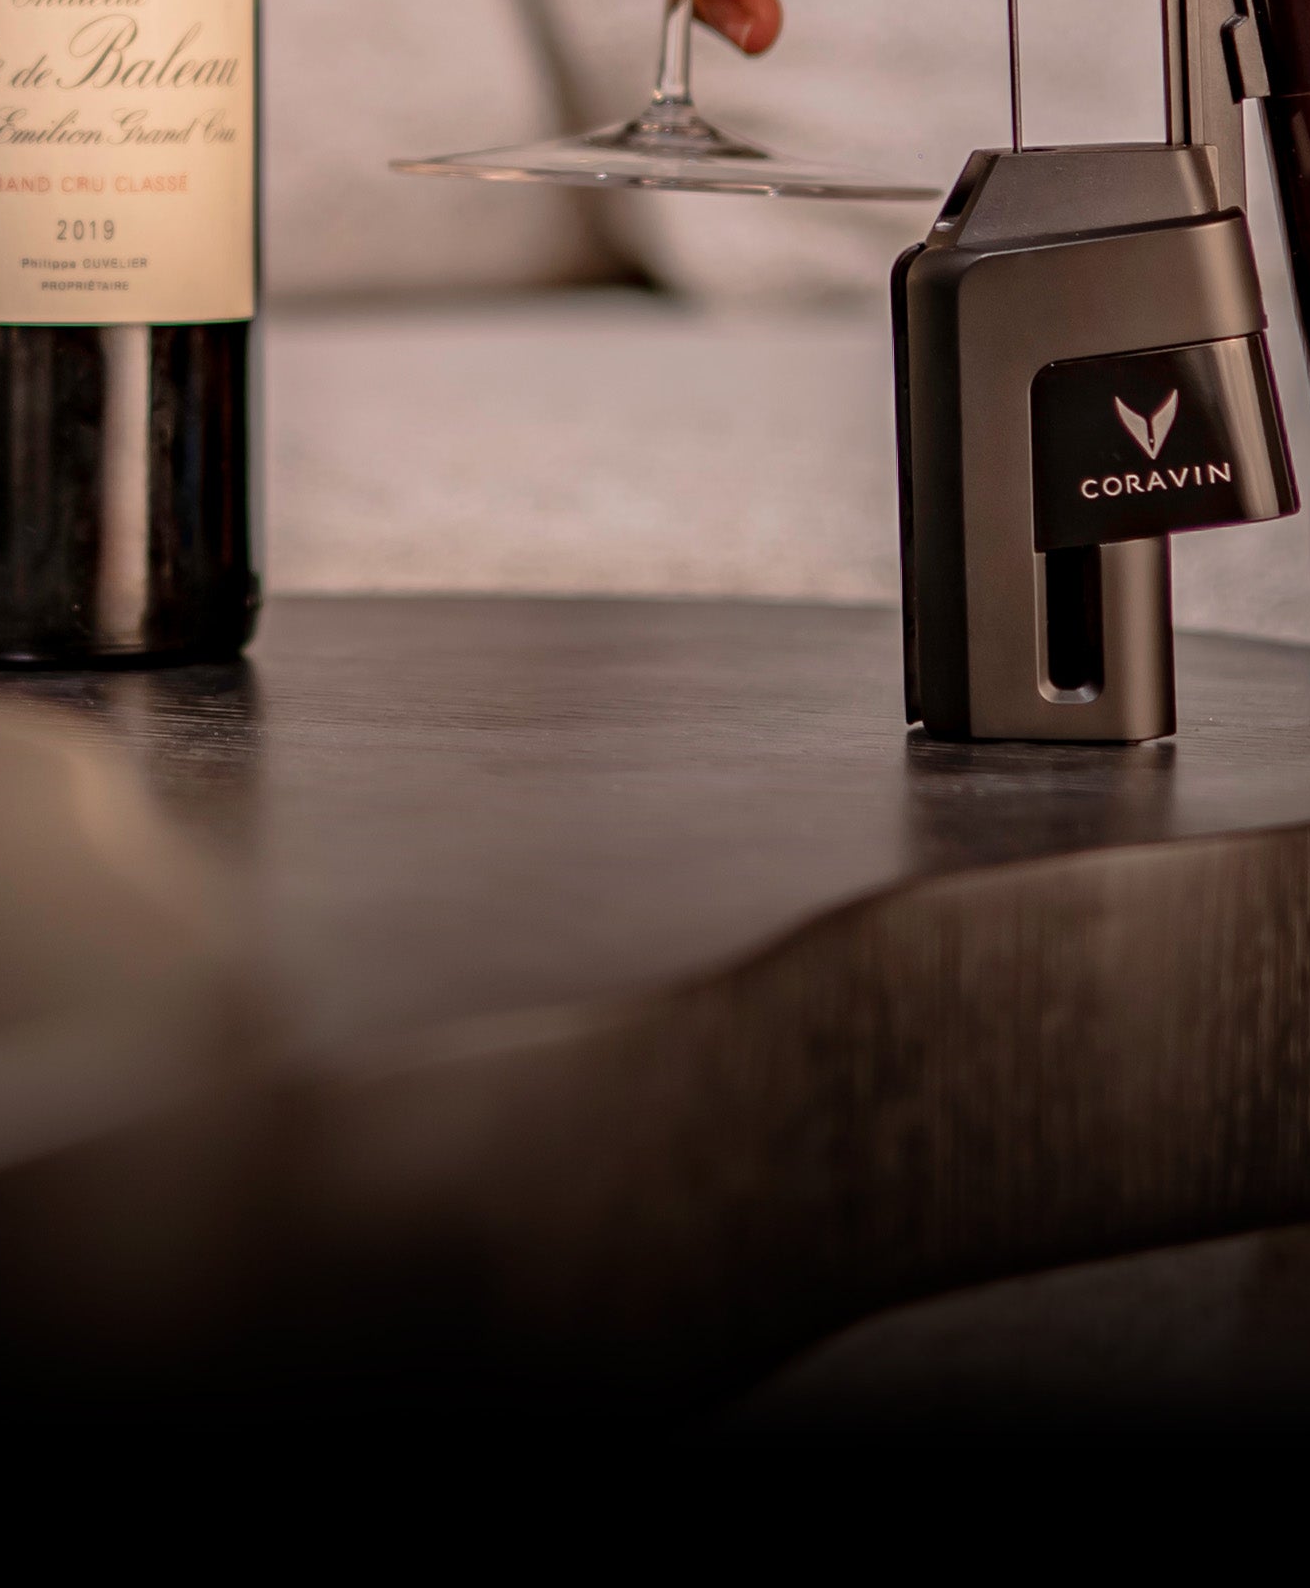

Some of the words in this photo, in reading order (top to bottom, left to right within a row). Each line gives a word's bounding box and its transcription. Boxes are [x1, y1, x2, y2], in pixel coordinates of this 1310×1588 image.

[10, 55, 52, 88] de
[56, 14, 240, 89] Baleau
[106, 108, 198, 145] Grand
[197, 108, 236, 144] Cru
[60, 175, 104, 193] CRU
[114, 171, 188, 192] CLASSÉ
[56, 219, 115, 241] 2019
[82, 257, 148, 269] CUVELIER
[1080, 462, 1233, 500] CORAVIN
